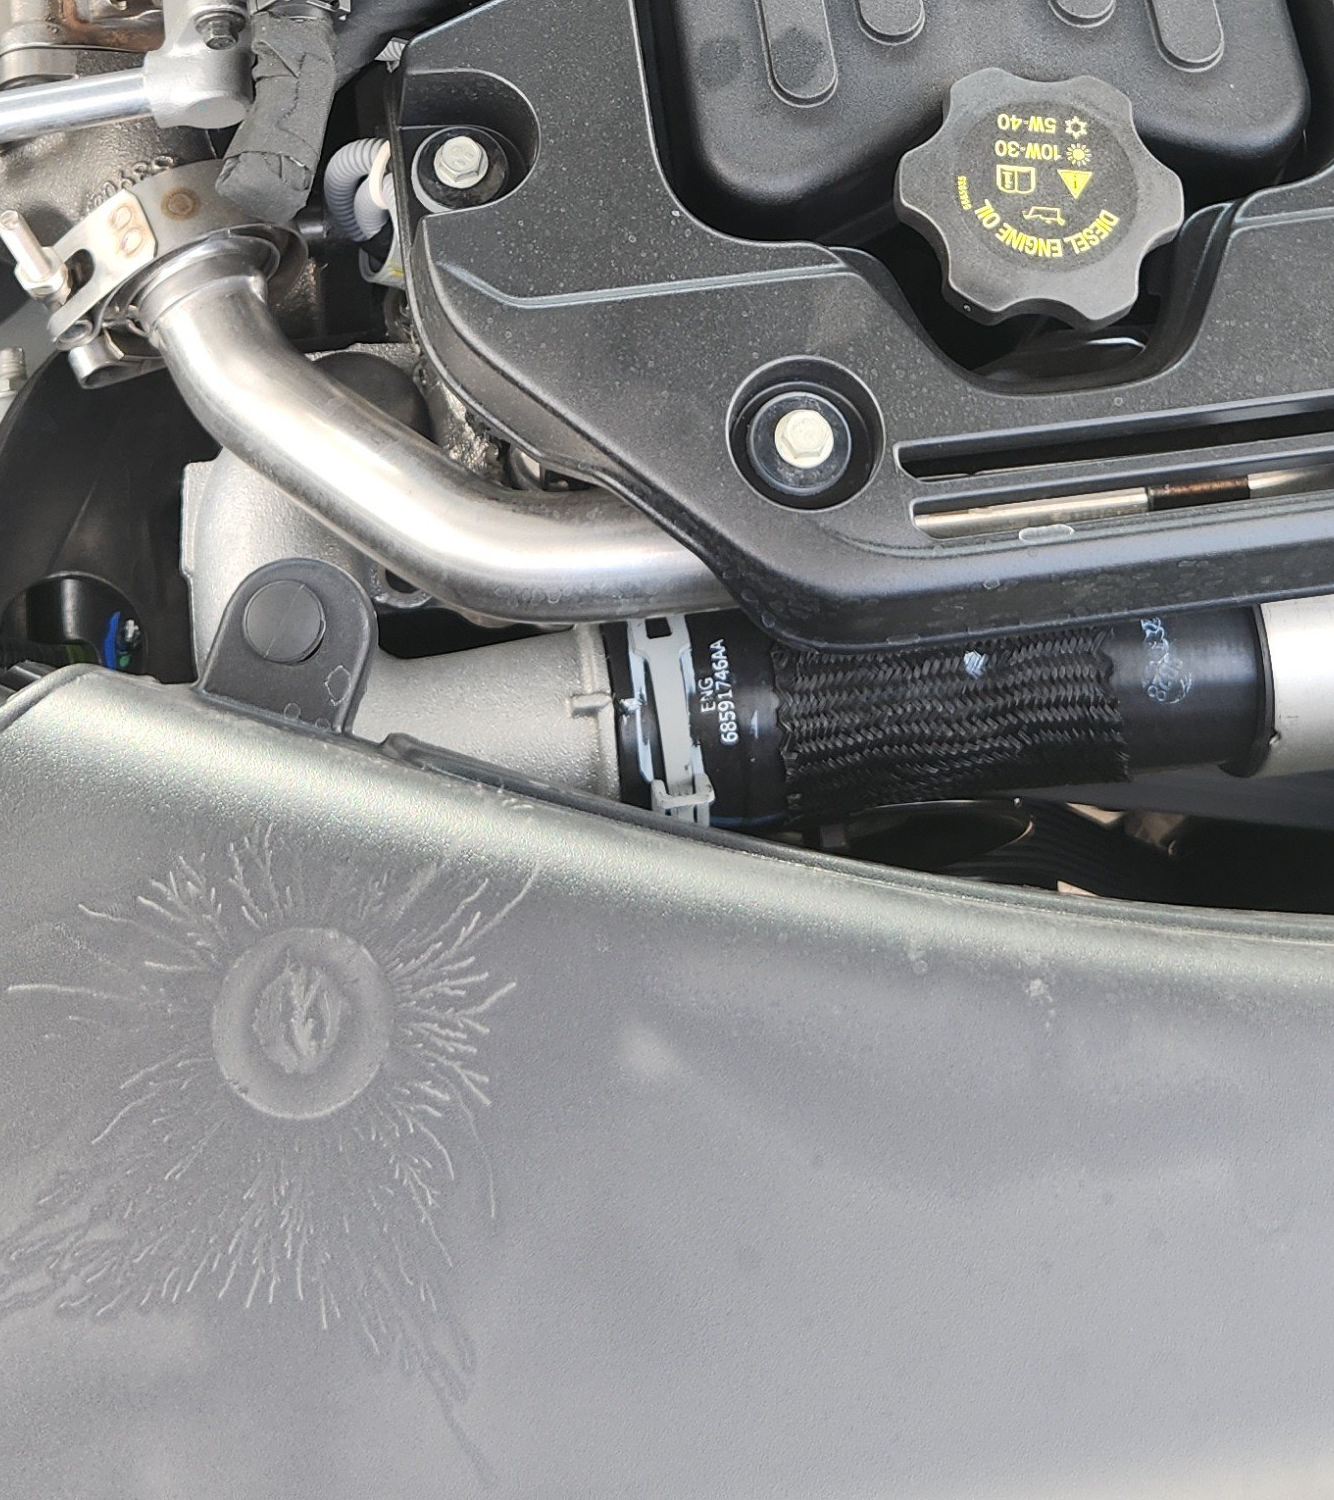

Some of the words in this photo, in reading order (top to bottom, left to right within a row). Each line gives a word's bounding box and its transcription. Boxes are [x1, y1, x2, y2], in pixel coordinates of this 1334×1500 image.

[997, 113, 1057, 134] 5W-40
[994, 140, 1062, 161] 10W-30
[974, 198, 1002, 230] OIL
[1063, 209, 1120, 254] DIESEL
[994, 222, 1064, 258] ENGINE
[698, 677, 716, 713] ENG
[710, 638, 739, 745] 68591746AA
